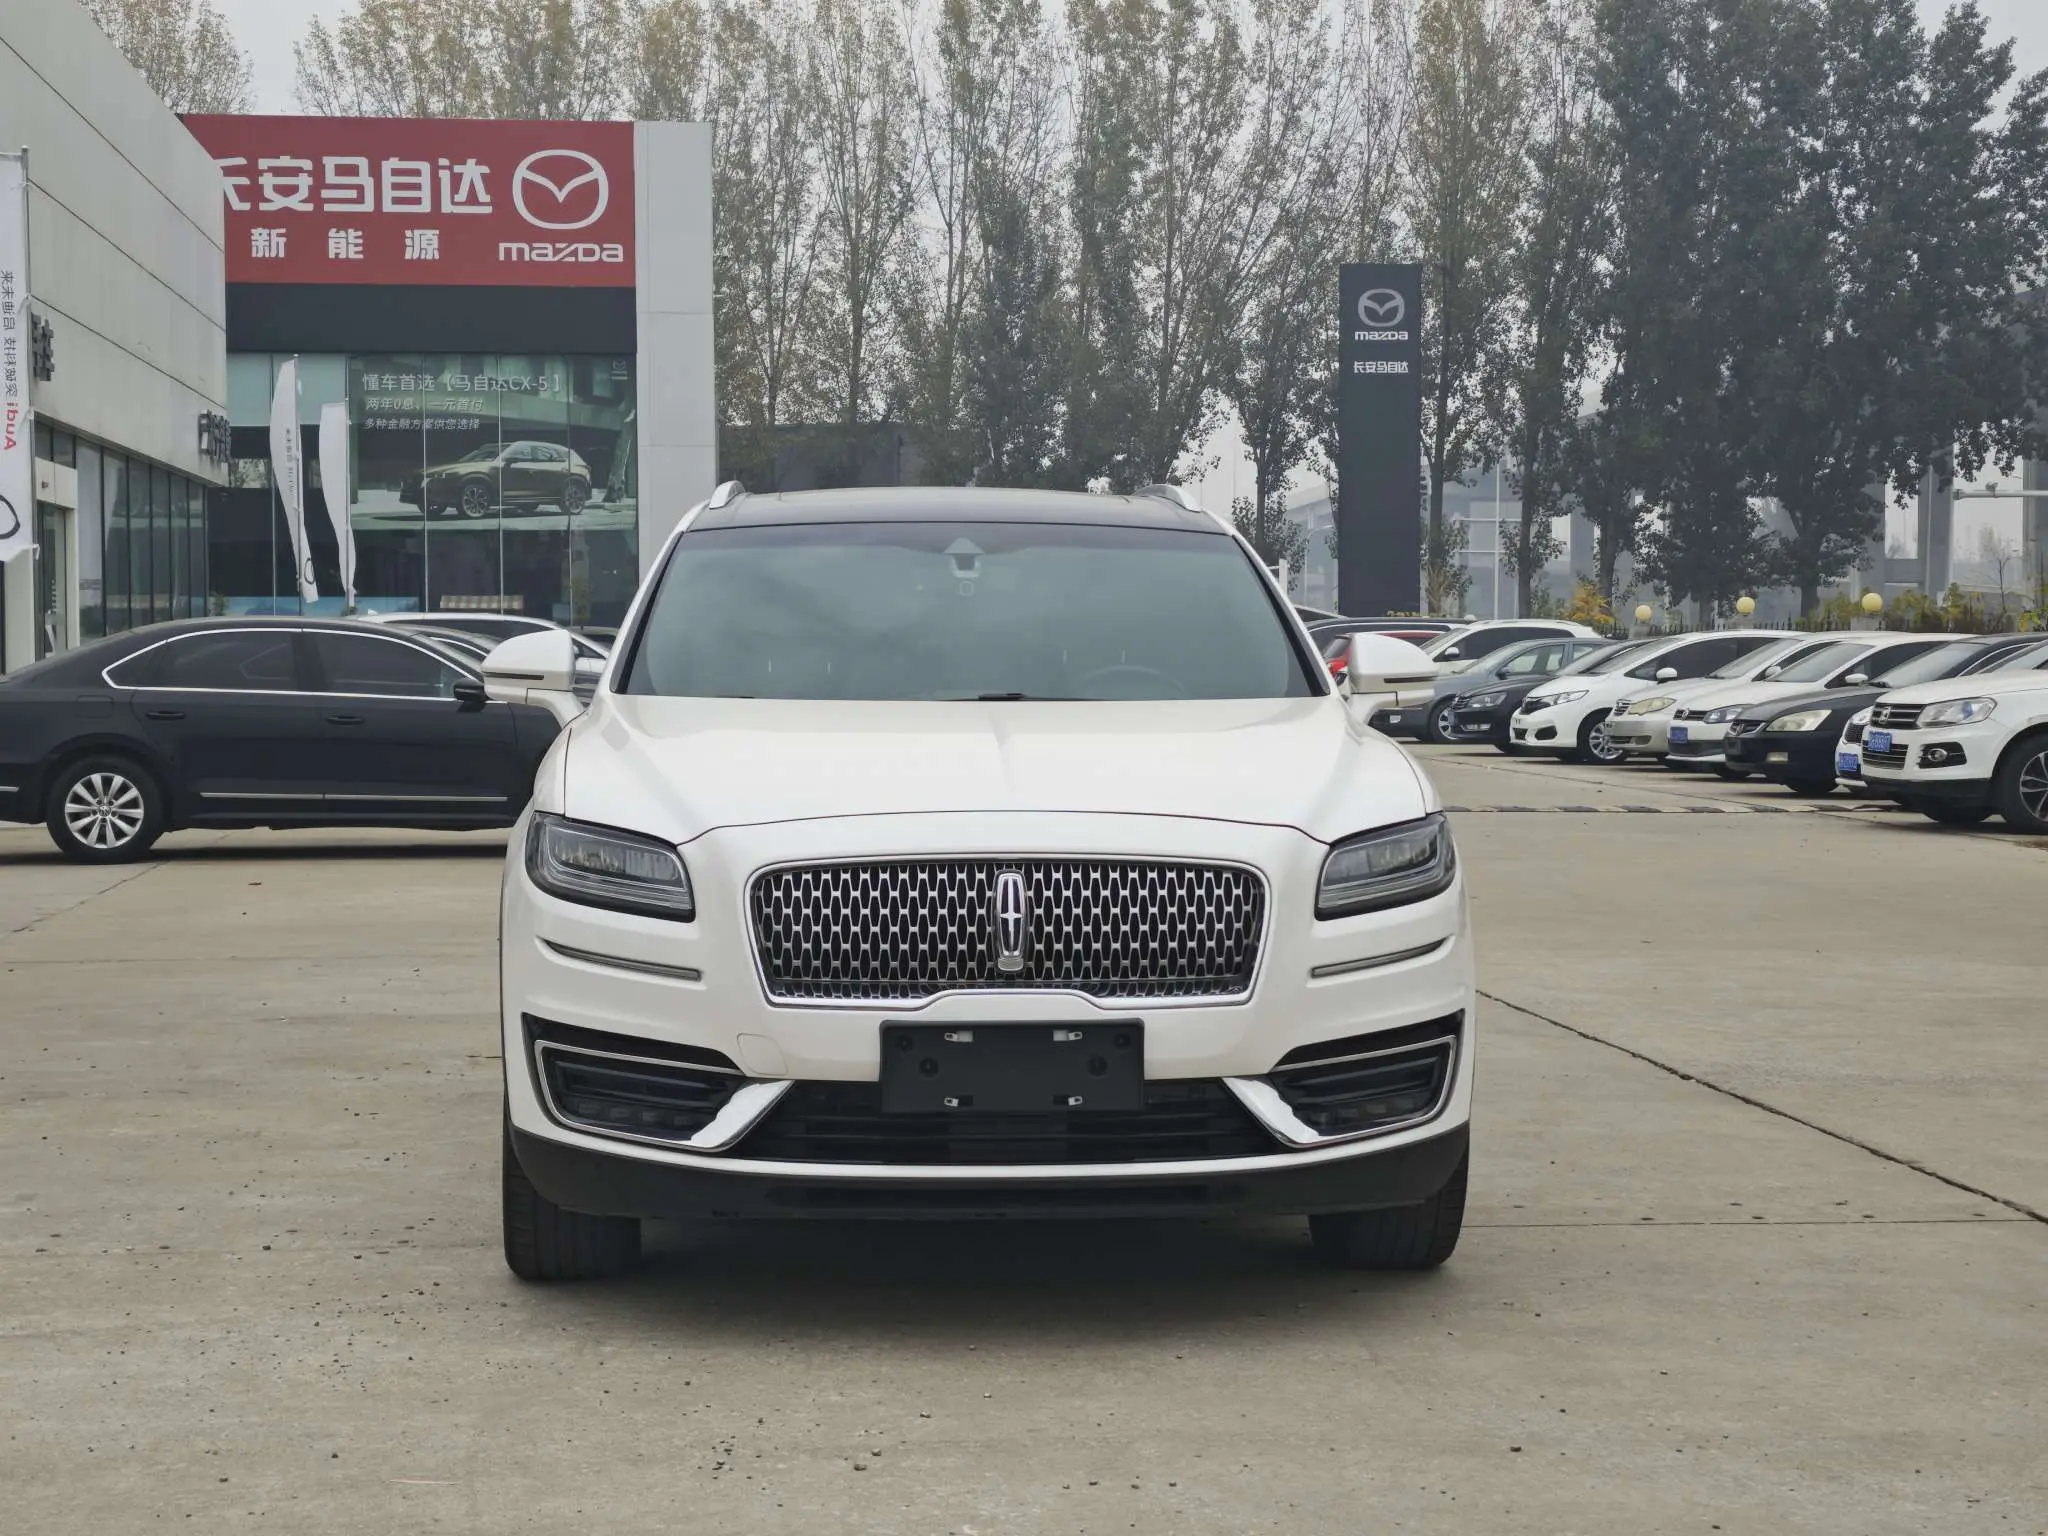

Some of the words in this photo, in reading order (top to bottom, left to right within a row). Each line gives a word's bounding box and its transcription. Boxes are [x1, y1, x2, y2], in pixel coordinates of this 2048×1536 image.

[250, 227, 440, 261] 新能源
[498, 242, 624, 263] mazda
[1354, 331, 1409, 341] mazda
[1353, 360, 1409, 374] 长安马自达
